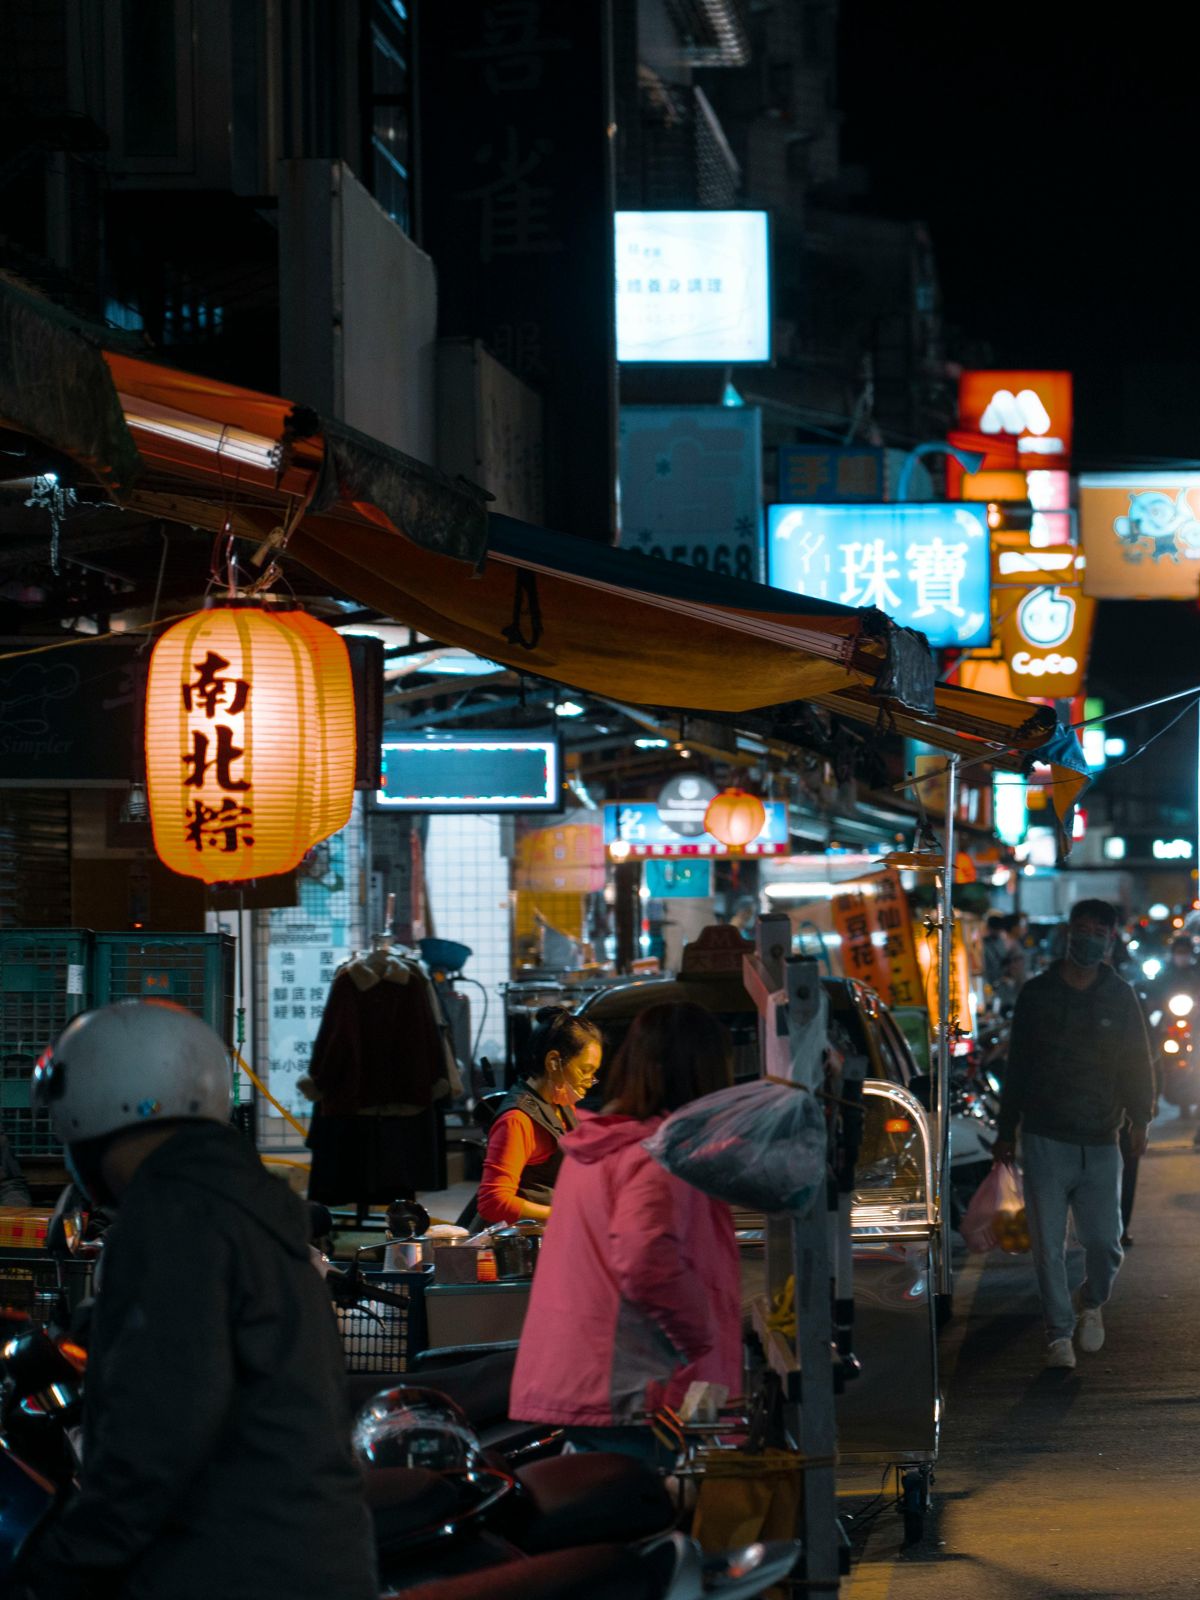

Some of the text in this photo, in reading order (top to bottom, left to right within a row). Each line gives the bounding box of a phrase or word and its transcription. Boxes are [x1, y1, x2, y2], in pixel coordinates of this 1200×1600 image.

[837, 536, 970, 618] 珠寶
[182, 651, 255, 852] 南北粽
